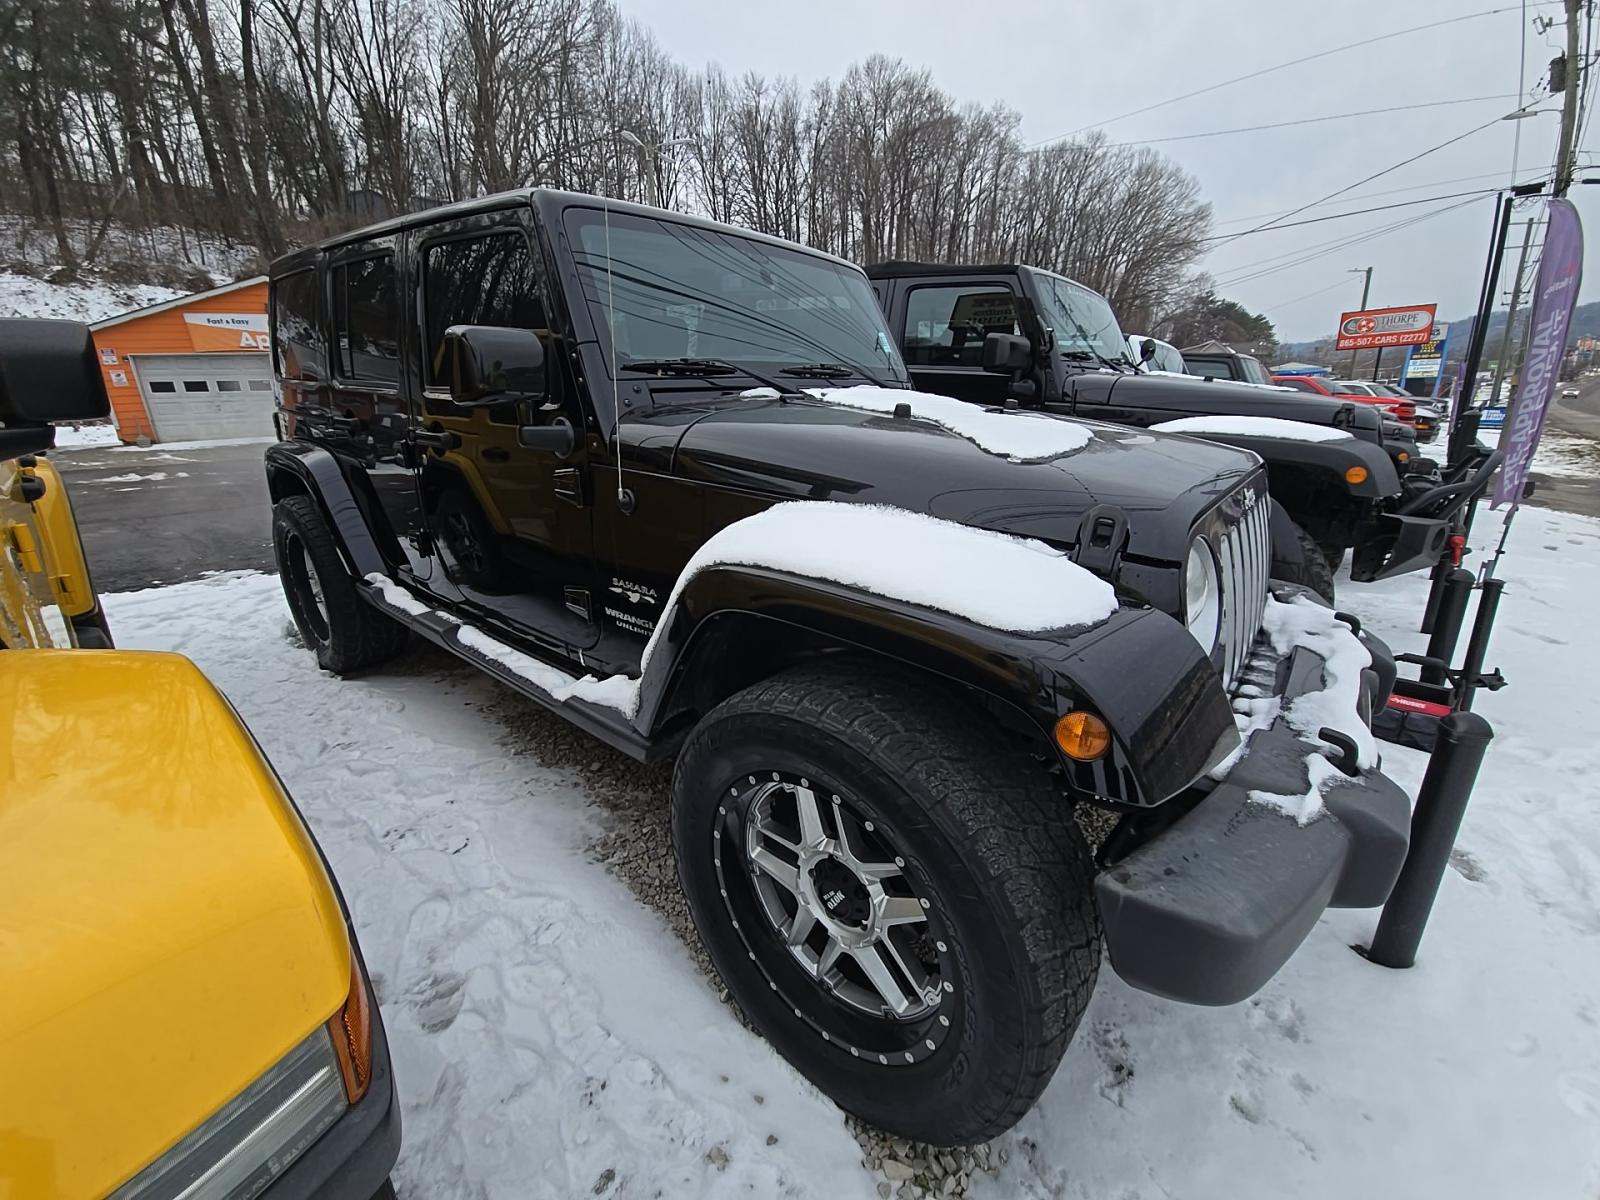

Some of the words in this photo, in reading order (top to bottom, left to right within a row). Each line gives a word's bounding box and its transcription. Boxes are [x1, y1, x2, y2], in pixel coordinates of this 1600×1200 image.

[231, 318, 249, 326] Easy
[1381, 312, 1420, 328] THORPE
[1503, 309, 1555, 495] PRE-APPROVAL
[611, 577, 658, 597] SAHARA
